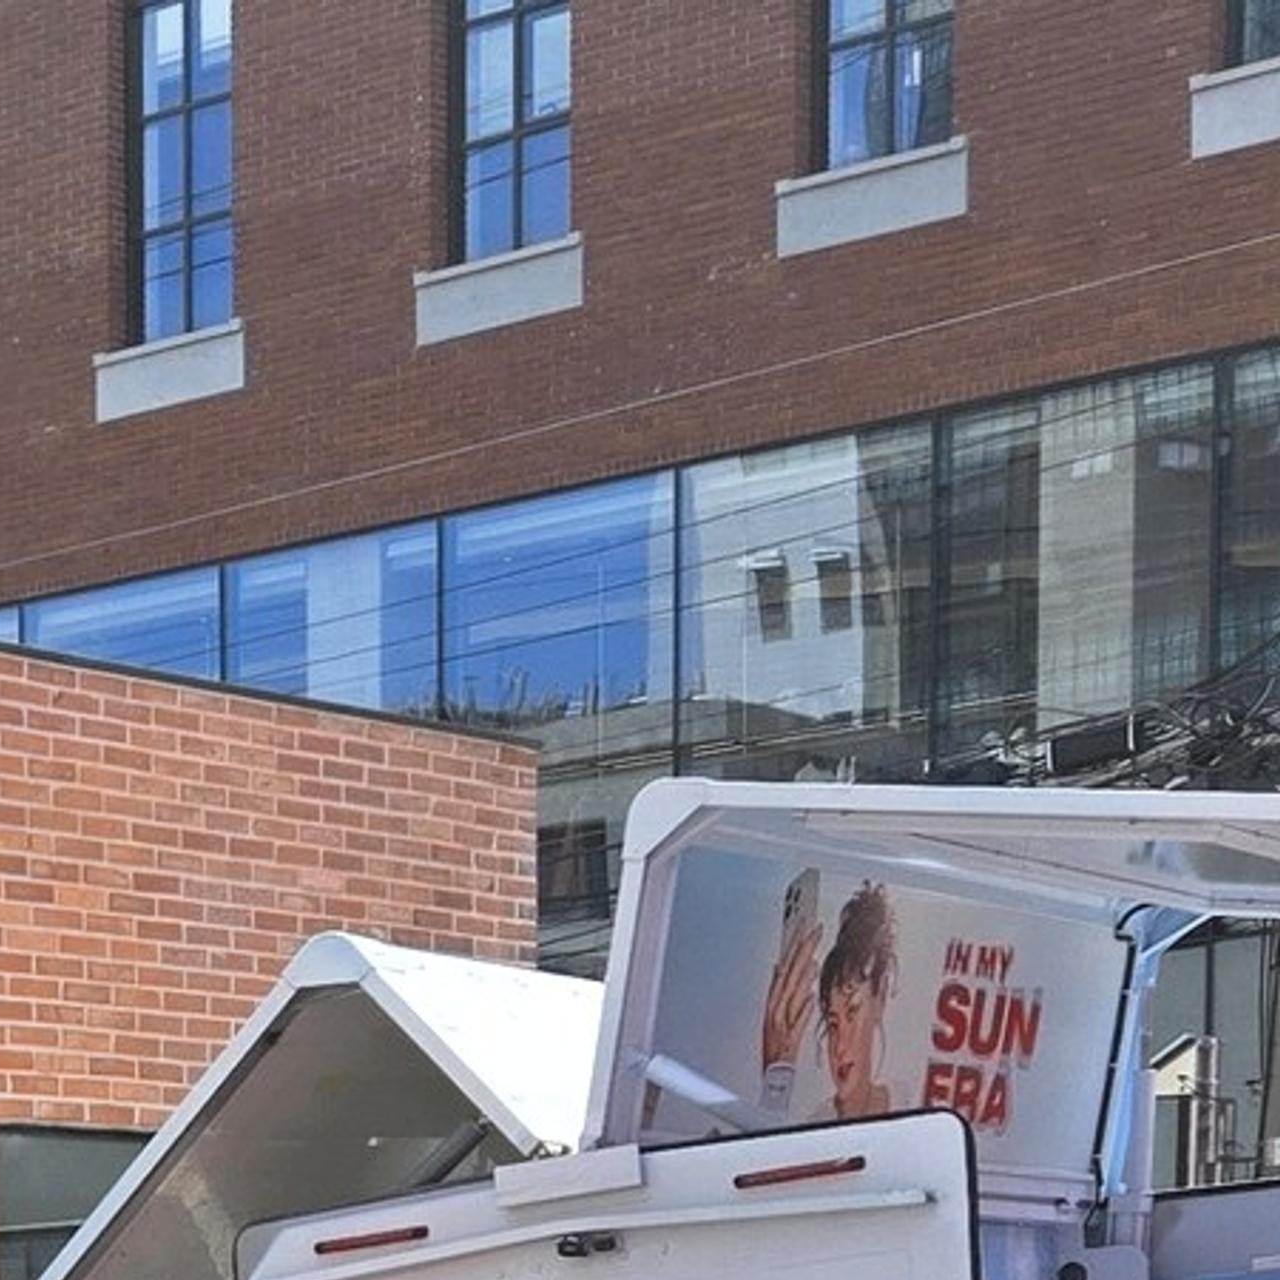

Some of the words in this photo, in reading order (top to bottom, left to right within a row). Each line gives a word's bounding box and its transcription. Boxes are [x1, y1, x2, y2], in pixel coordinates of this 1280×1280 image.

[976, 947, 1013, 984] MY
[932, 983, 1041, 1058] SUN
[924, 1062, 1007, 1127] ERA
